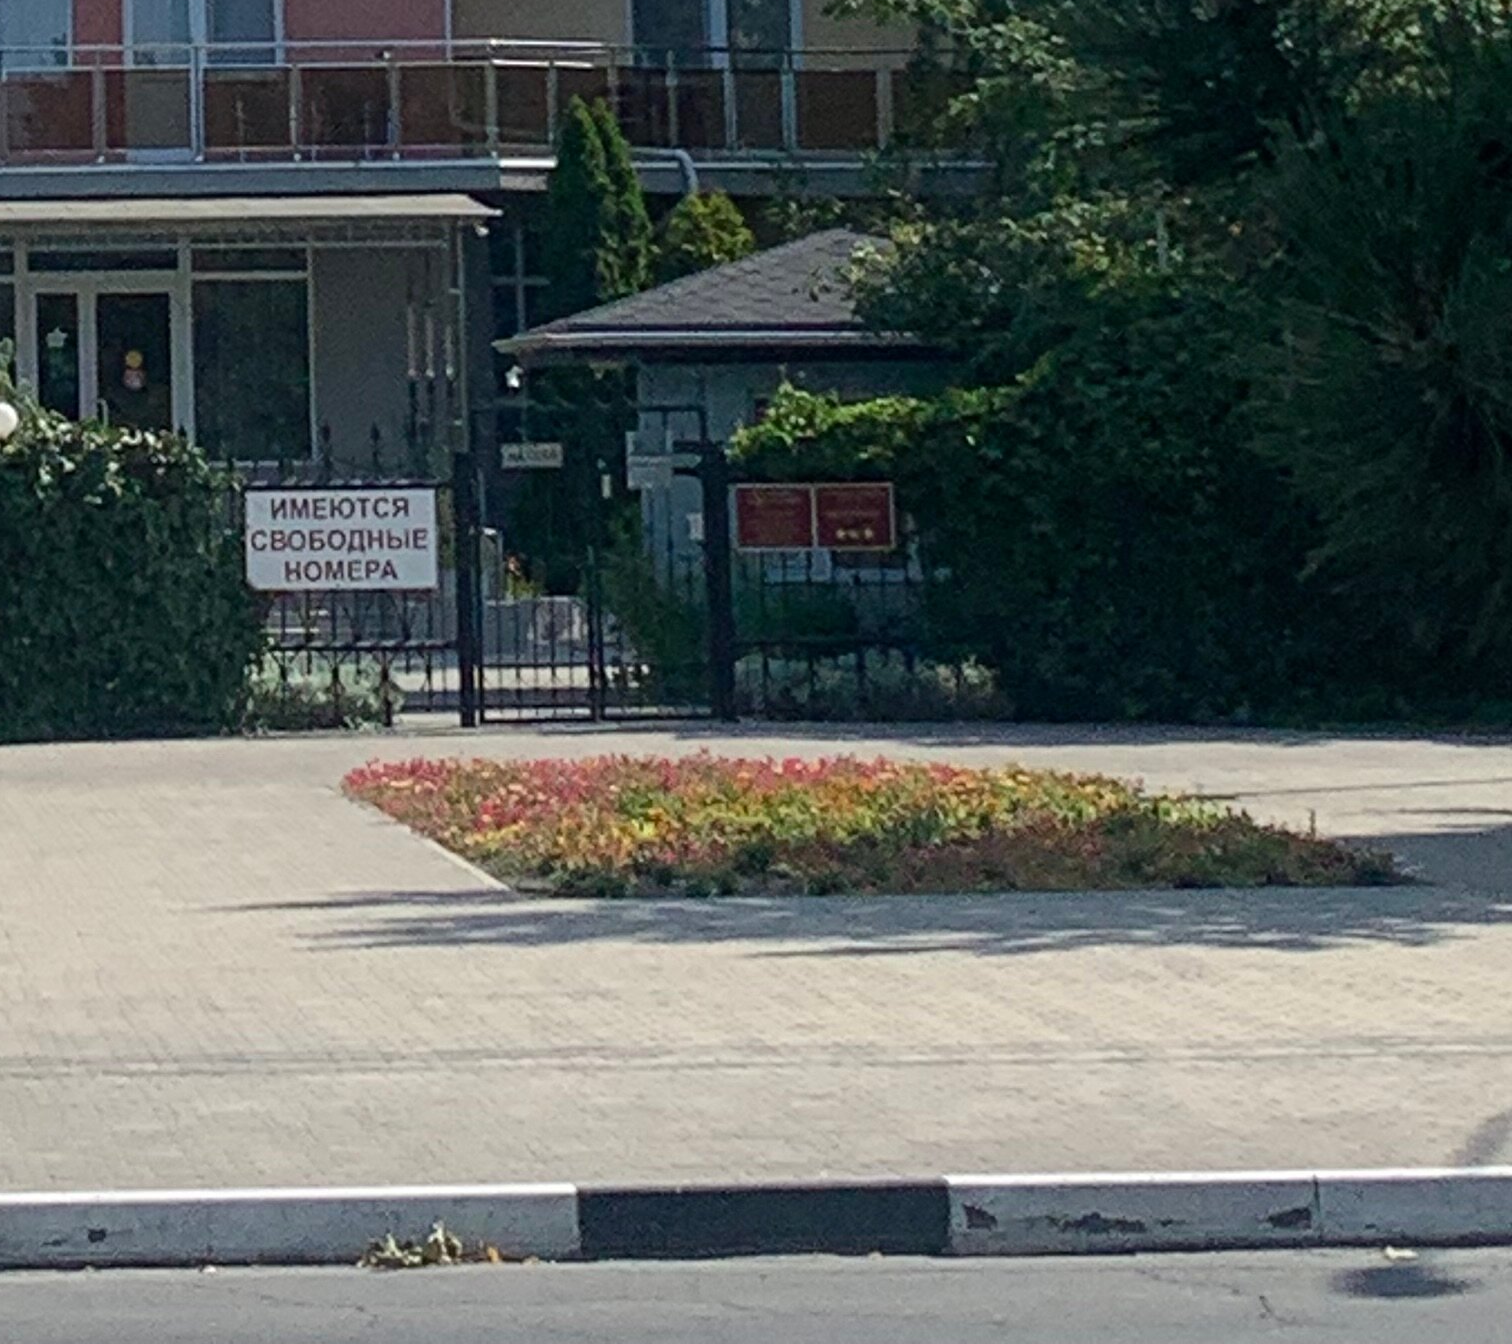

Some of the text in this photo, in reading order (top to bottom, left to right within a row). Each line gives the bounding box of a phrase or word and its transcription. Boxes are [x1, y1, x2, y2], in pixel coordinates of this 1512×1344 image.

[270, 497, 410, 520] ИМЕЮТСЯ
[251, 528, 428, 554] СВОБОДНЫЕ
[284, 559, 398, 582] НОМЕРА
